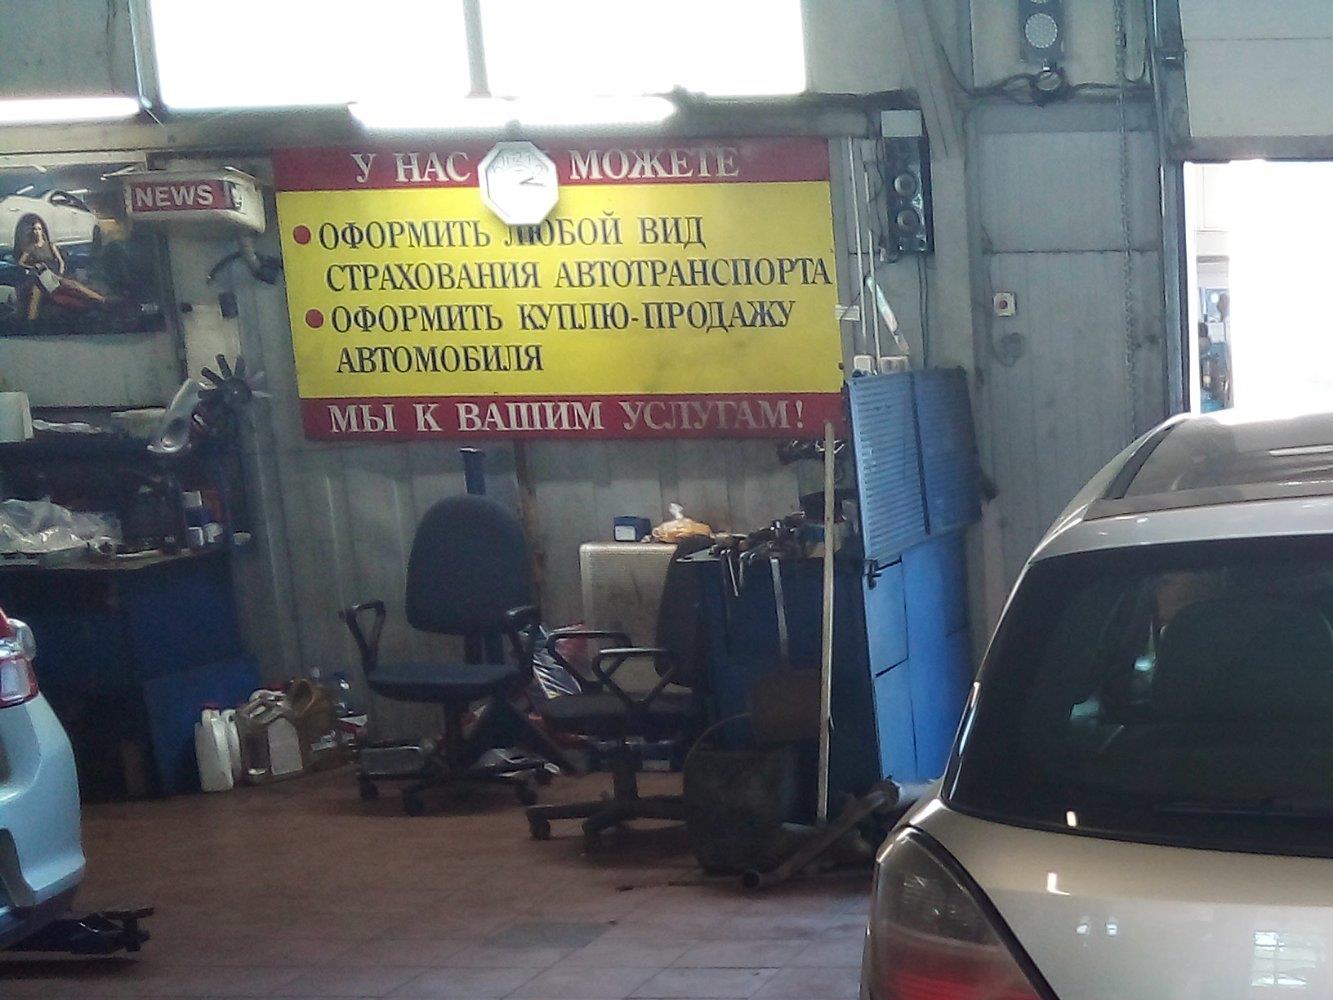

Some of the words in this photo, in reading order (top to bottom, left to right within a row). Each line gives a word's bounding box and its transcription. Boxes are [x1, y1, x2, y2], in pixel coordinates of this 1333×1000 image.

[350, 152, 377, 184] У
[394, 151, 472, 183] НАС
[567, 147, 740, 180] МОЖЕТЕ
[134, 184, 215, 208] NEWS
[318, 220, 491, 250] ОФОРМИТЬ
[503, 211, 624, 247] ЛЮБОЙ
[637, 216, 707, 250] ВИД
[325, 261, 543, 293] СТРАХОВАНИЯ
[554, 257, 833, 289] АВТОТРАНСПОРТА
[330, 304, 504, 333] ОФОРМИТЬ
[516, 300, 797, 333] КУПЛЮ-ПРОДАЖУ
[335, 344, 545, 374] АВТОМОБИЛЯ
[327, 403, 398, 434] МЫ
[412, 403, 444, 433] К
[455, 401, 605, 432] ВАШИМ
[618, 399, 805, 431] УСЛУГАМ!
